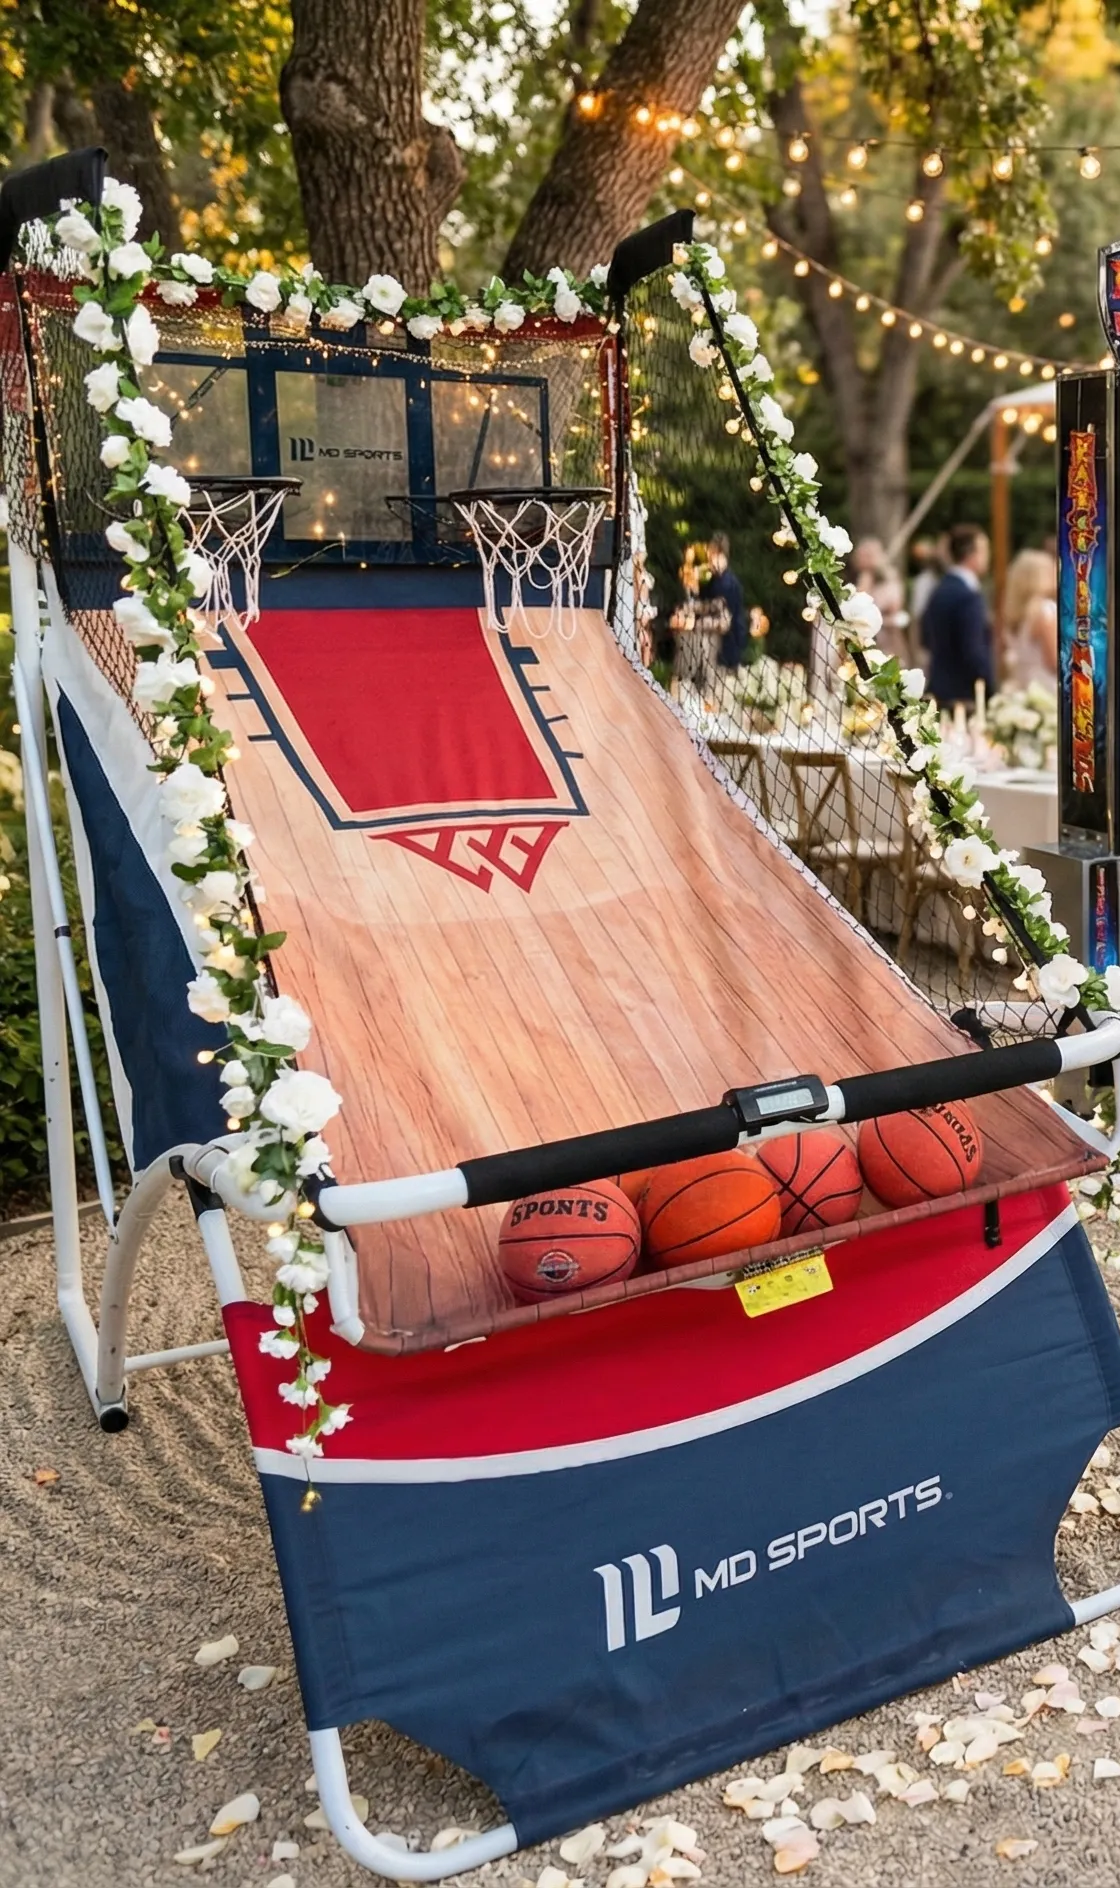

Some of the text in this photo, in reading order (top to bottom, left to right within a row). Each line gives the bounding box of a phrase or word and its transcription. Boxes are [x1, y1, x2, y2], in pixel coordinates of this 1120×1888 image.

[318, 447, 404, 461] MD SPORTS
[694, 1474, 943, 1599] MD SPORTS
